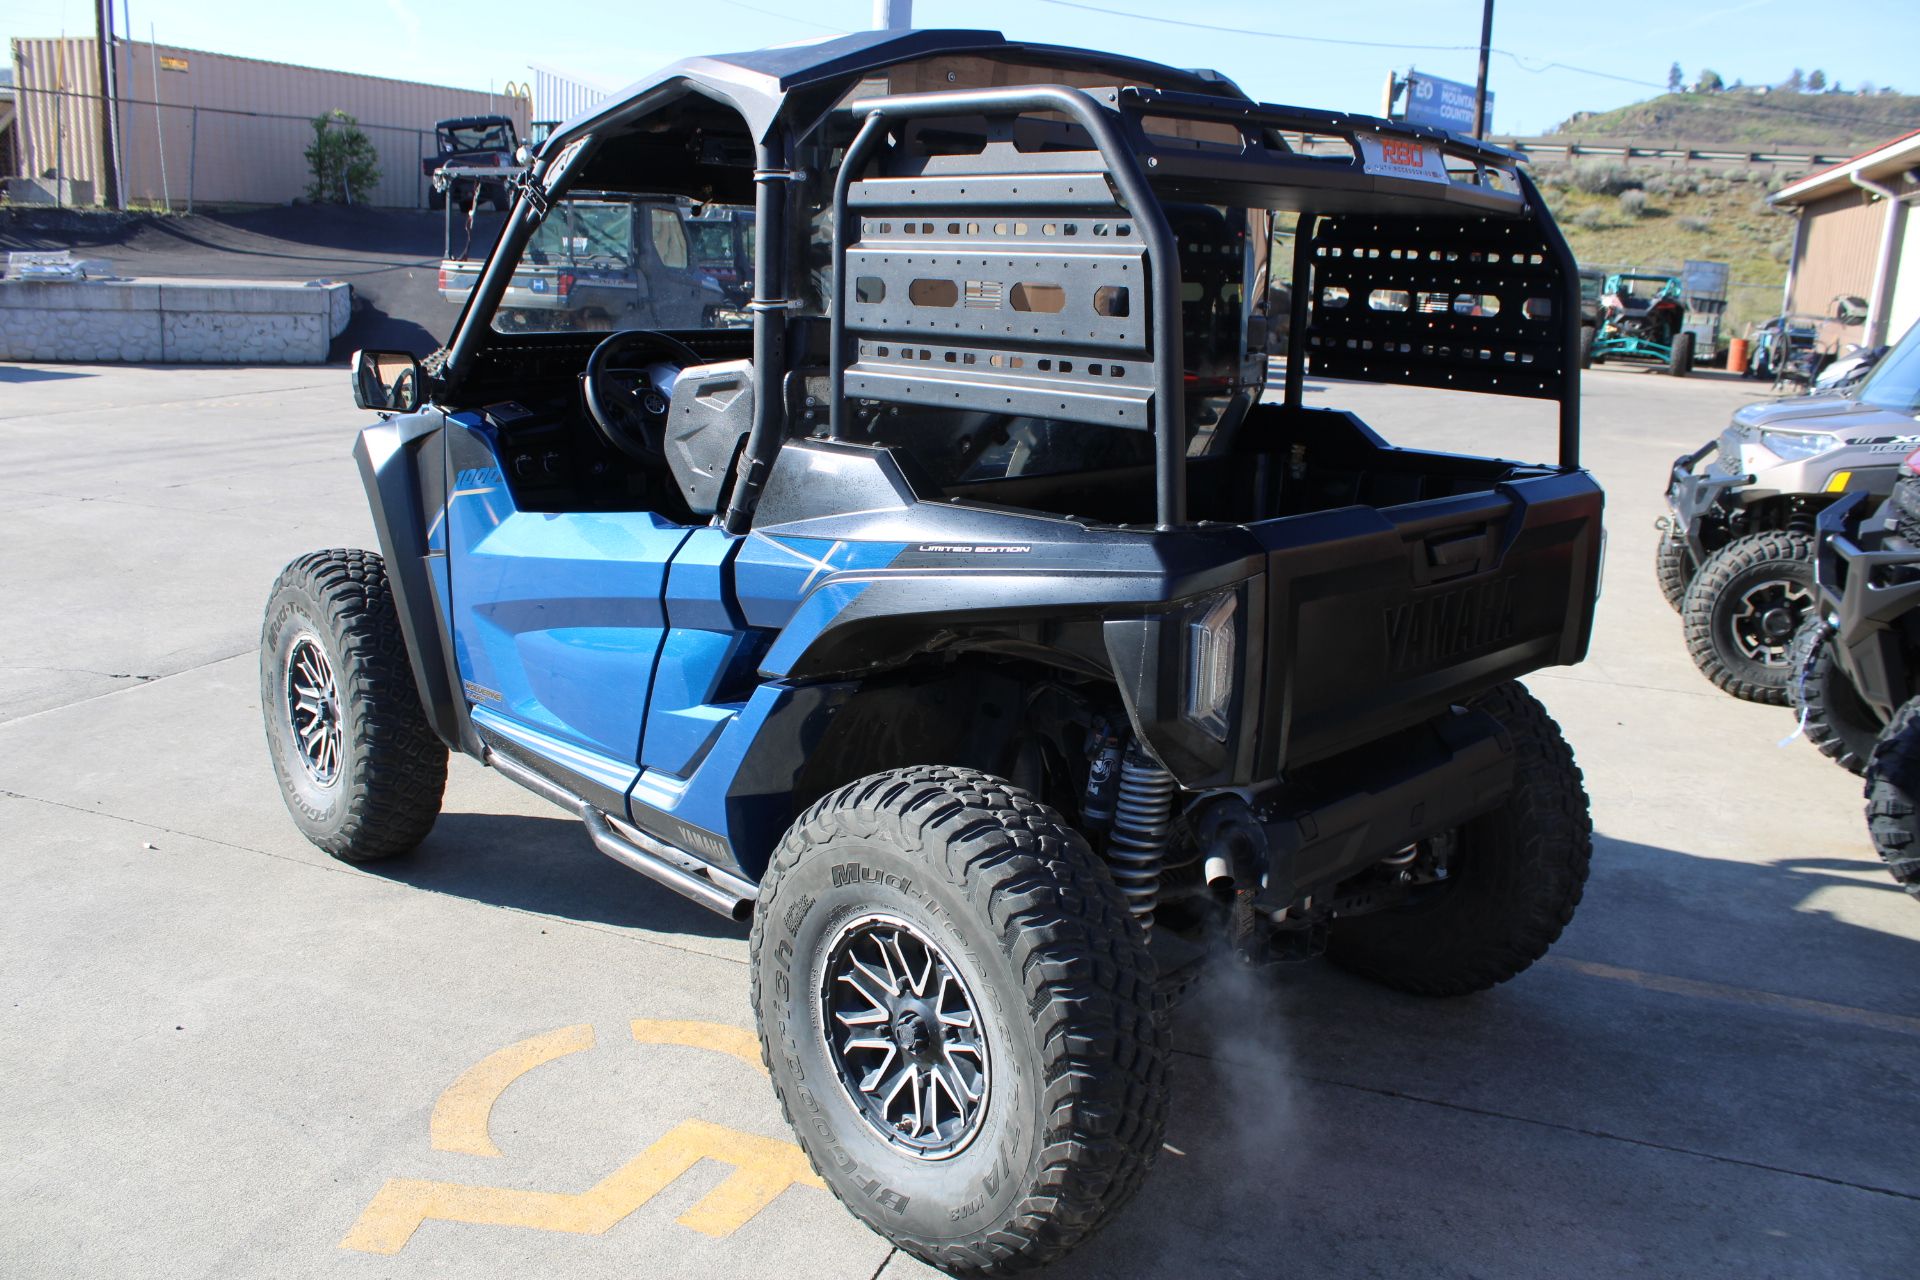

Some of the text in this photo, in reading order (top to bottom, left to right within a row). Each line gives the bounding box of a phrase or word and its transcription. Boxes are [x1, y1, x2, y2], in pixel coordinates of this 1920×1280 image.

[919, 545, 973, 553] LIMITED
[1383, 574, 1519, 672] YAMAHA
[678, 825, 730, 860] YAMAHA
